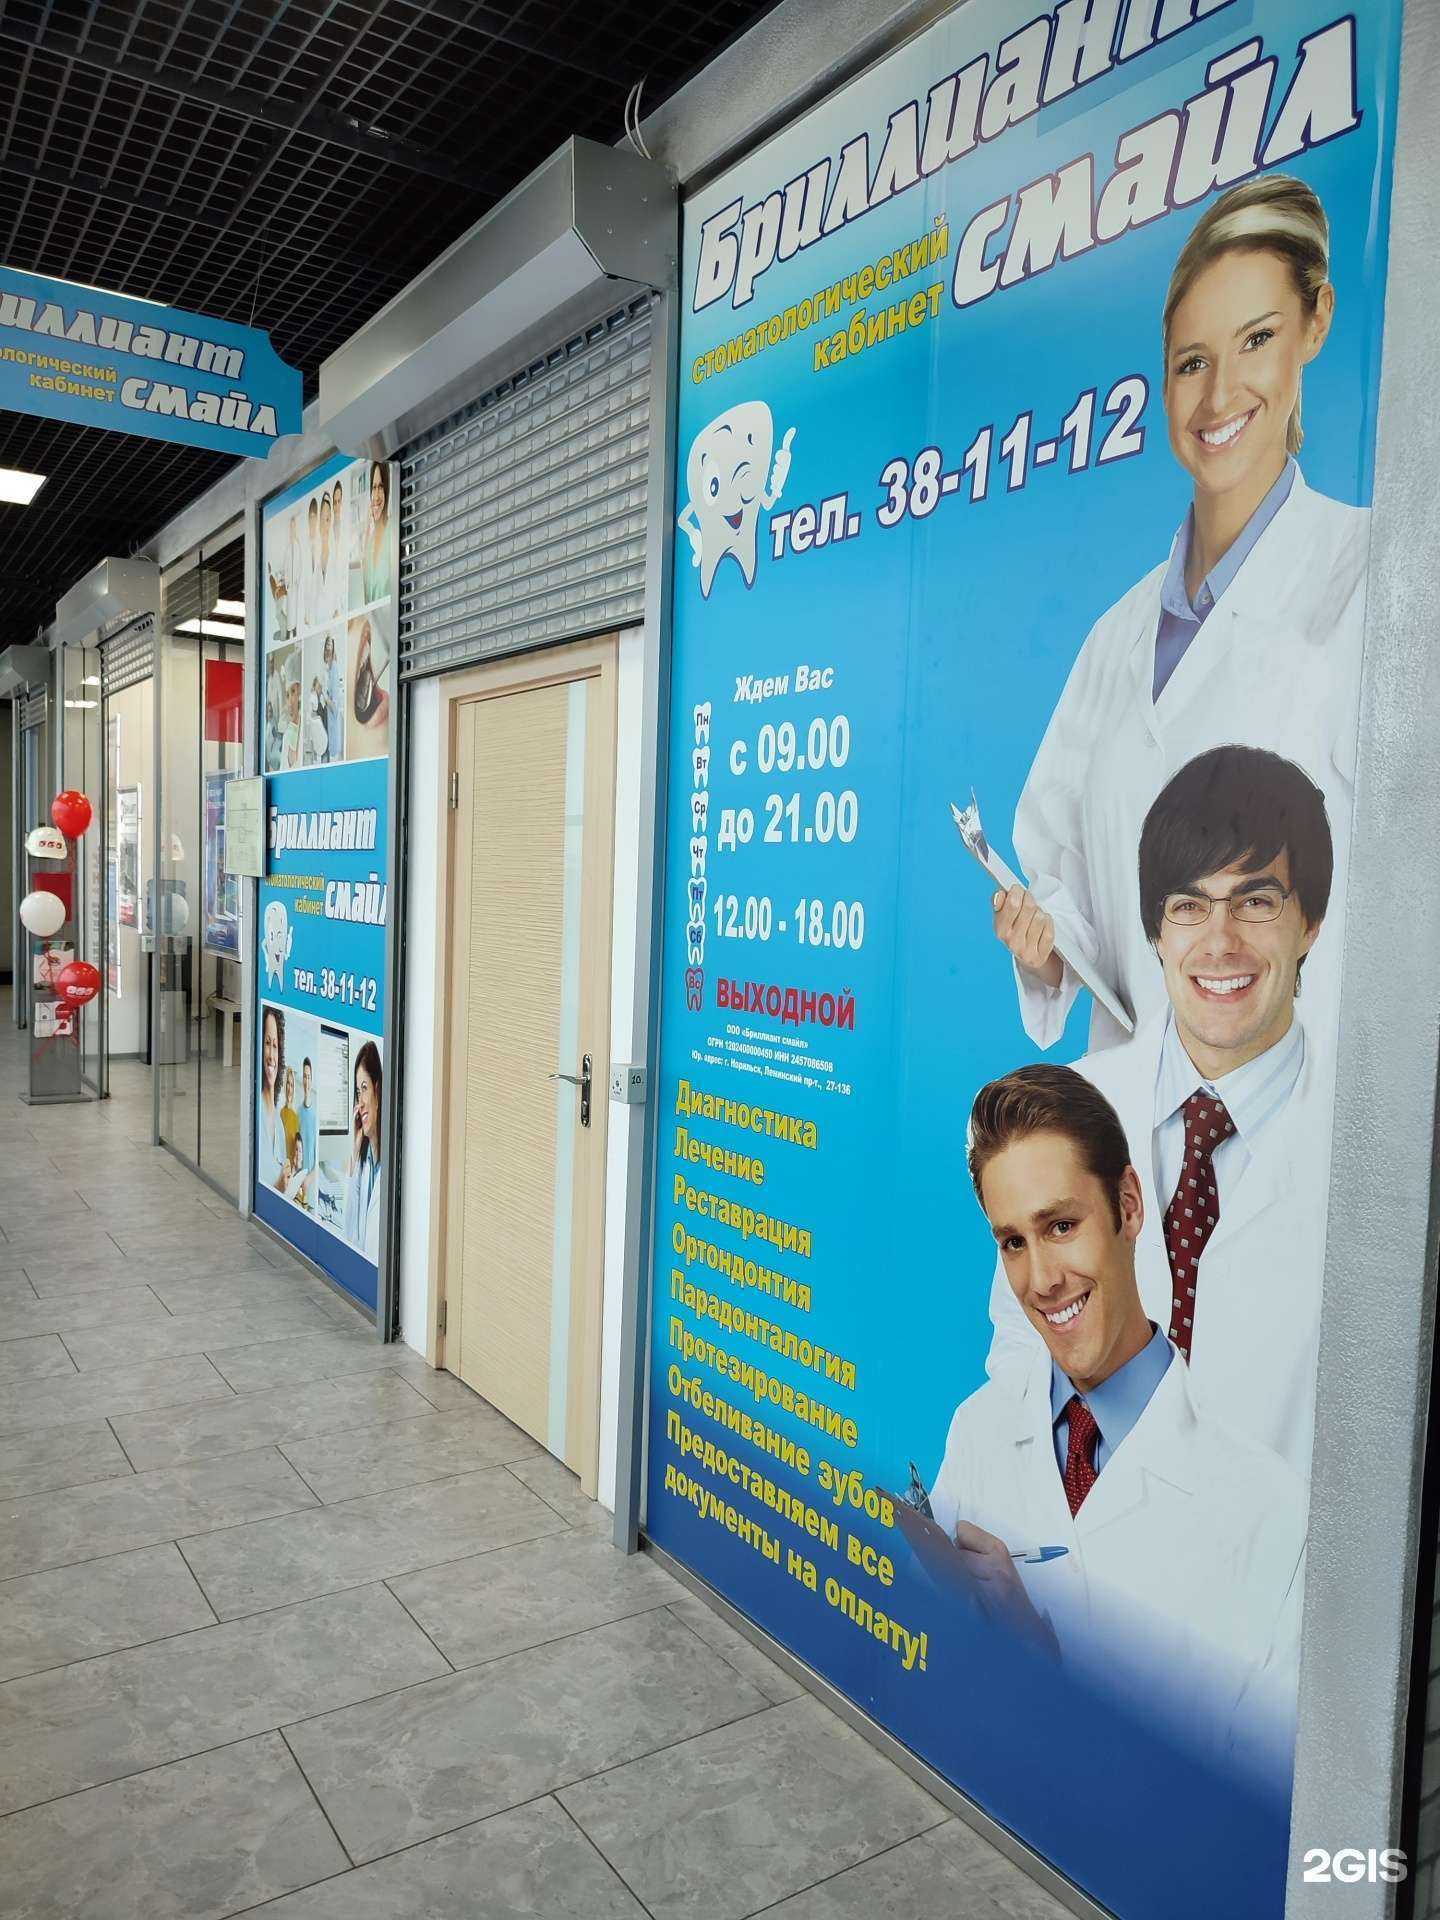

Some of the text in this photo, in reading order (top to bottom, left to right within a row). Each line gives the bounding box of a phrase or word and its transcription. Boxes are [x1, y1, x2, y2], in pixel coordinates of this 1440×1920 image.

[951, 14, 1363, 308] смайл
[691, 214, 949, 384] стоматологический
[812, 280, 945, 372] кабинет
[0, 347, 117, 383] логический
[30, 373, 115, 402] кабинет
[120, 376, 279, 437] смайл
[768, 374, 1149, 560] тел. 38-11-12
[734, 665, 834, 704] Ждем Вас
[696, 713, 709, 726] Пн
[729, 714, 850, 776] с 09.00
[696, 757, 707, 769] Вт
[694, 801, 706, 816] Ср
[717, 790, 858, 852] до 21.00
[693, 845, 704, 858] Чт
[693, 887, 704, 900] Пт
[714, 894, 772, 942] 12.00
[795, 897, 865, 950] 18.00
[690, 930, 702, 943] Сб
[294, 967, 377, 1012] тел. 38-11-12
[689, 978, 700, 990] Вс
[716, 976, 856, 1031] ВЫХОДНОЙ
[707, 1036, 724, 1049] ОГРН
[774, 1050, 790, 1063] ИНН
[726, 1024, 740, 1036] ООО
[675, 1079, 818, 1150] Диагностика
[826, 1079, 851, 1095] 27-136
[674, 1126, 765, 1185] Лечение
[673, 1174, 812, 1258] Реставрация
[672, 1222, 811, 1313] Ортондонтия
[671, 1268, 857, 1391] Парадонталогия
[669, 1315, 859, 1448] Протезирование
[668, 1364, 896, 1529] Отбеливание зубов
[666, 1409, 895, 1587] Предоставляем все
[664, 1463, 928, 1673] документы на оплату!
